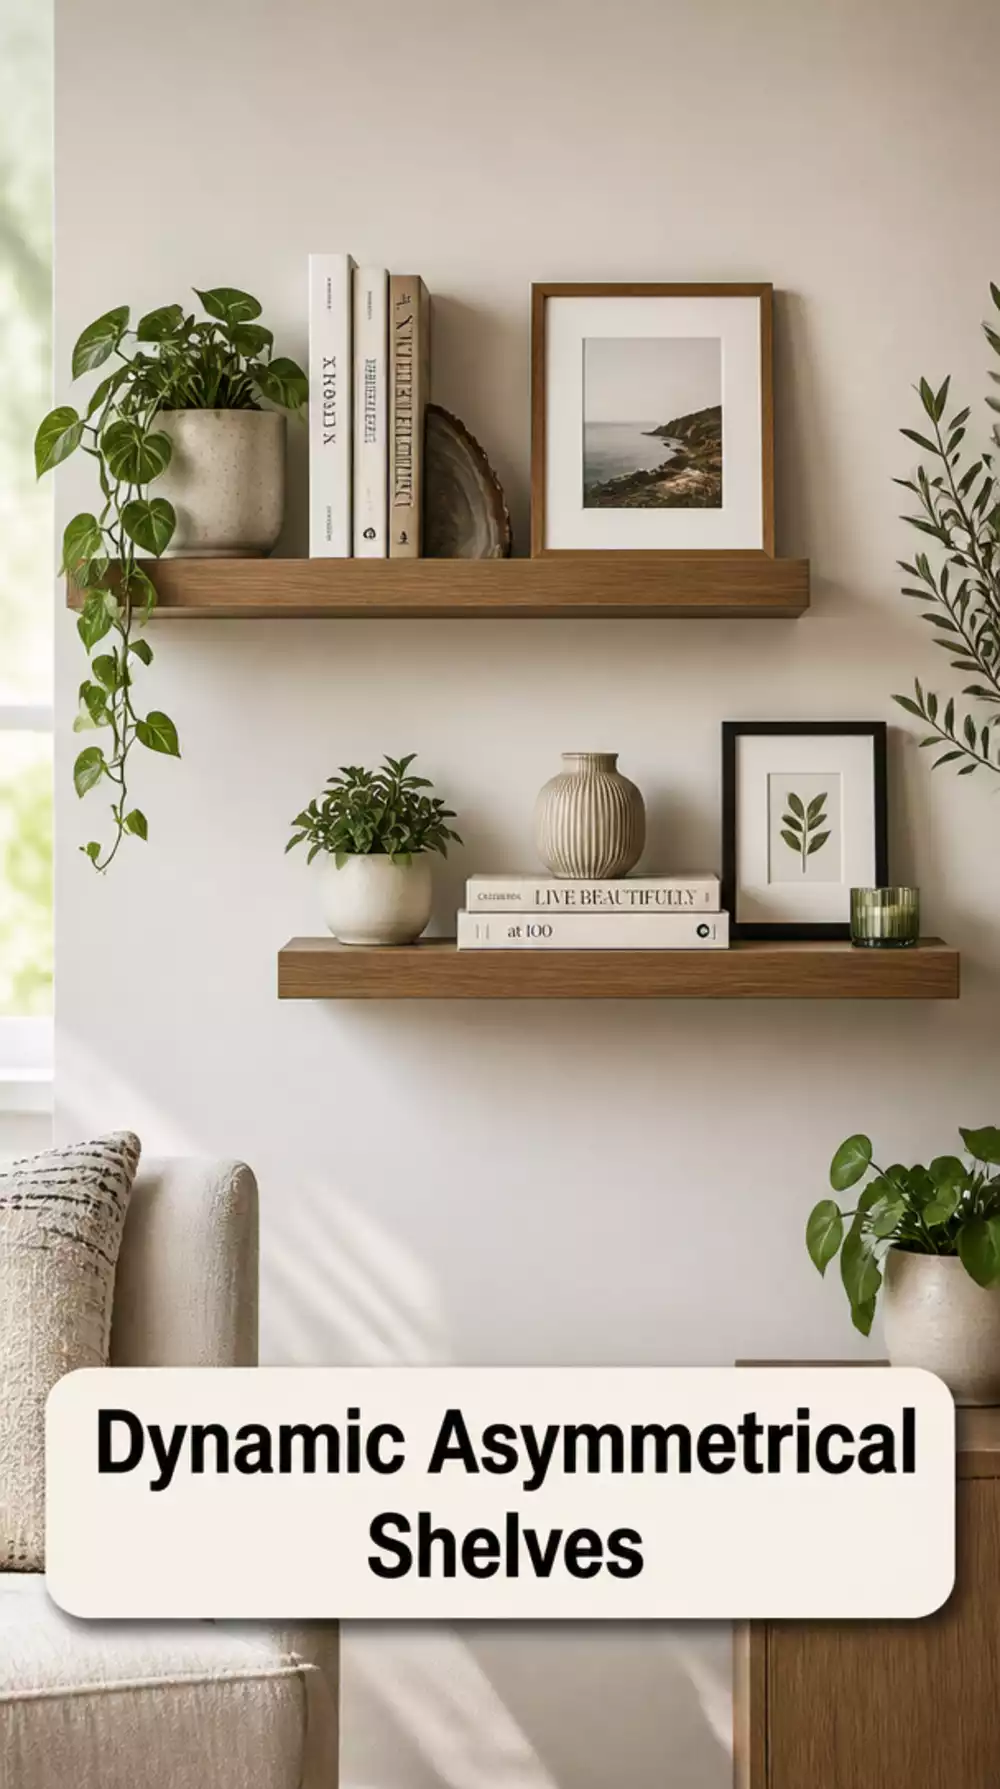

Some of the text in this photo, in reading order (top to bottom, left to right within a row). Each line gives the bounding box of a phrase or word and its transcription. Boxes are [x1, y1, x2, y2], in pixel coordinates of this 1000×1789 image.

[535, 889, 576, 906] LIVE
[580, 889, 697, 906] BEAUTIFULLY
[507, 925, 522, 938] at
